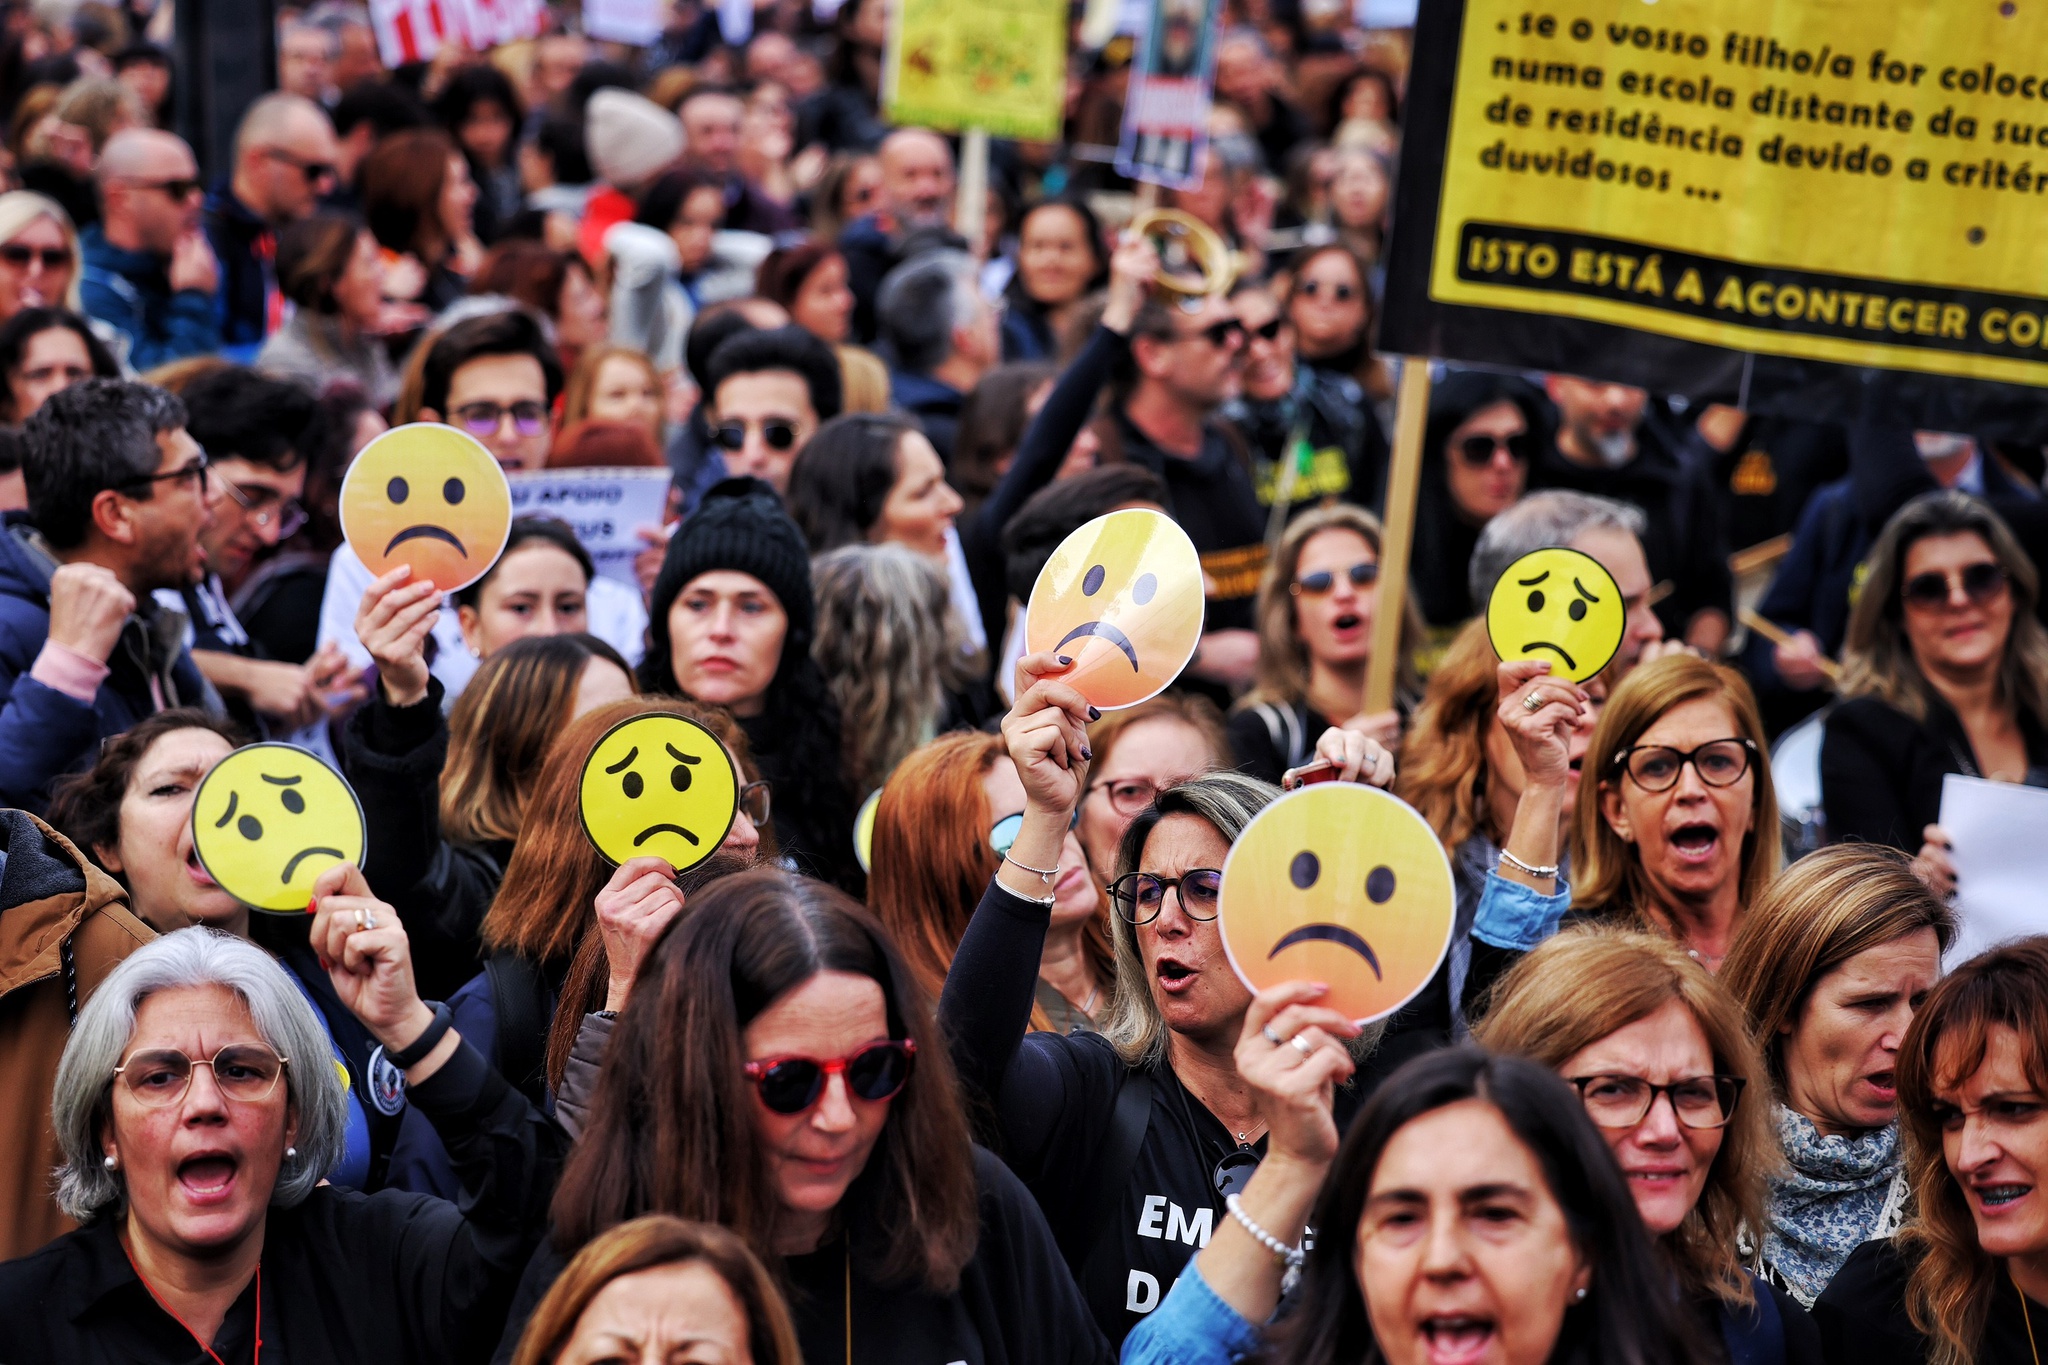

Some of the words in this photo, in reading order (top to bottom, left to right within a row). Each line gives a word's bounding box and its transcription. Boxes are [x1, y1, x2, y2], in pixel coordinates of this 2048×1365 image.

[1520, 13, 1557, 38] se
[1570, 18, 1593, 42] o
[1606, 22, 1710, 58] vosso
[1722, 31, 1855, 78] filho/a
[1869, 50, 1926, 86] for
[1491, 56, 1603, 90] numa
[1618, 75, 1735, 110] escola
[1750, 86, 1914, 132] distante
[1928, 106, 1978, 140] da
[1479, 139, 1670, 193] duvidosos
[1485, 94, 1533, 127] de
[1547, 107, 1744, 157] residência
[1758, 135, 1892, 176] devido
[1905, 158, 1930, 182] a
[1467, 235, 1560, 280] ISTO
[1568, 247, 1665, 297] ESTÁ
[1673, 267, 1706, 305] A
[1713, 275, 1970, 340] ACONTECER
[1978, 307, 2048, 350] CO
[1126, 1269, 1178, 1314] D
